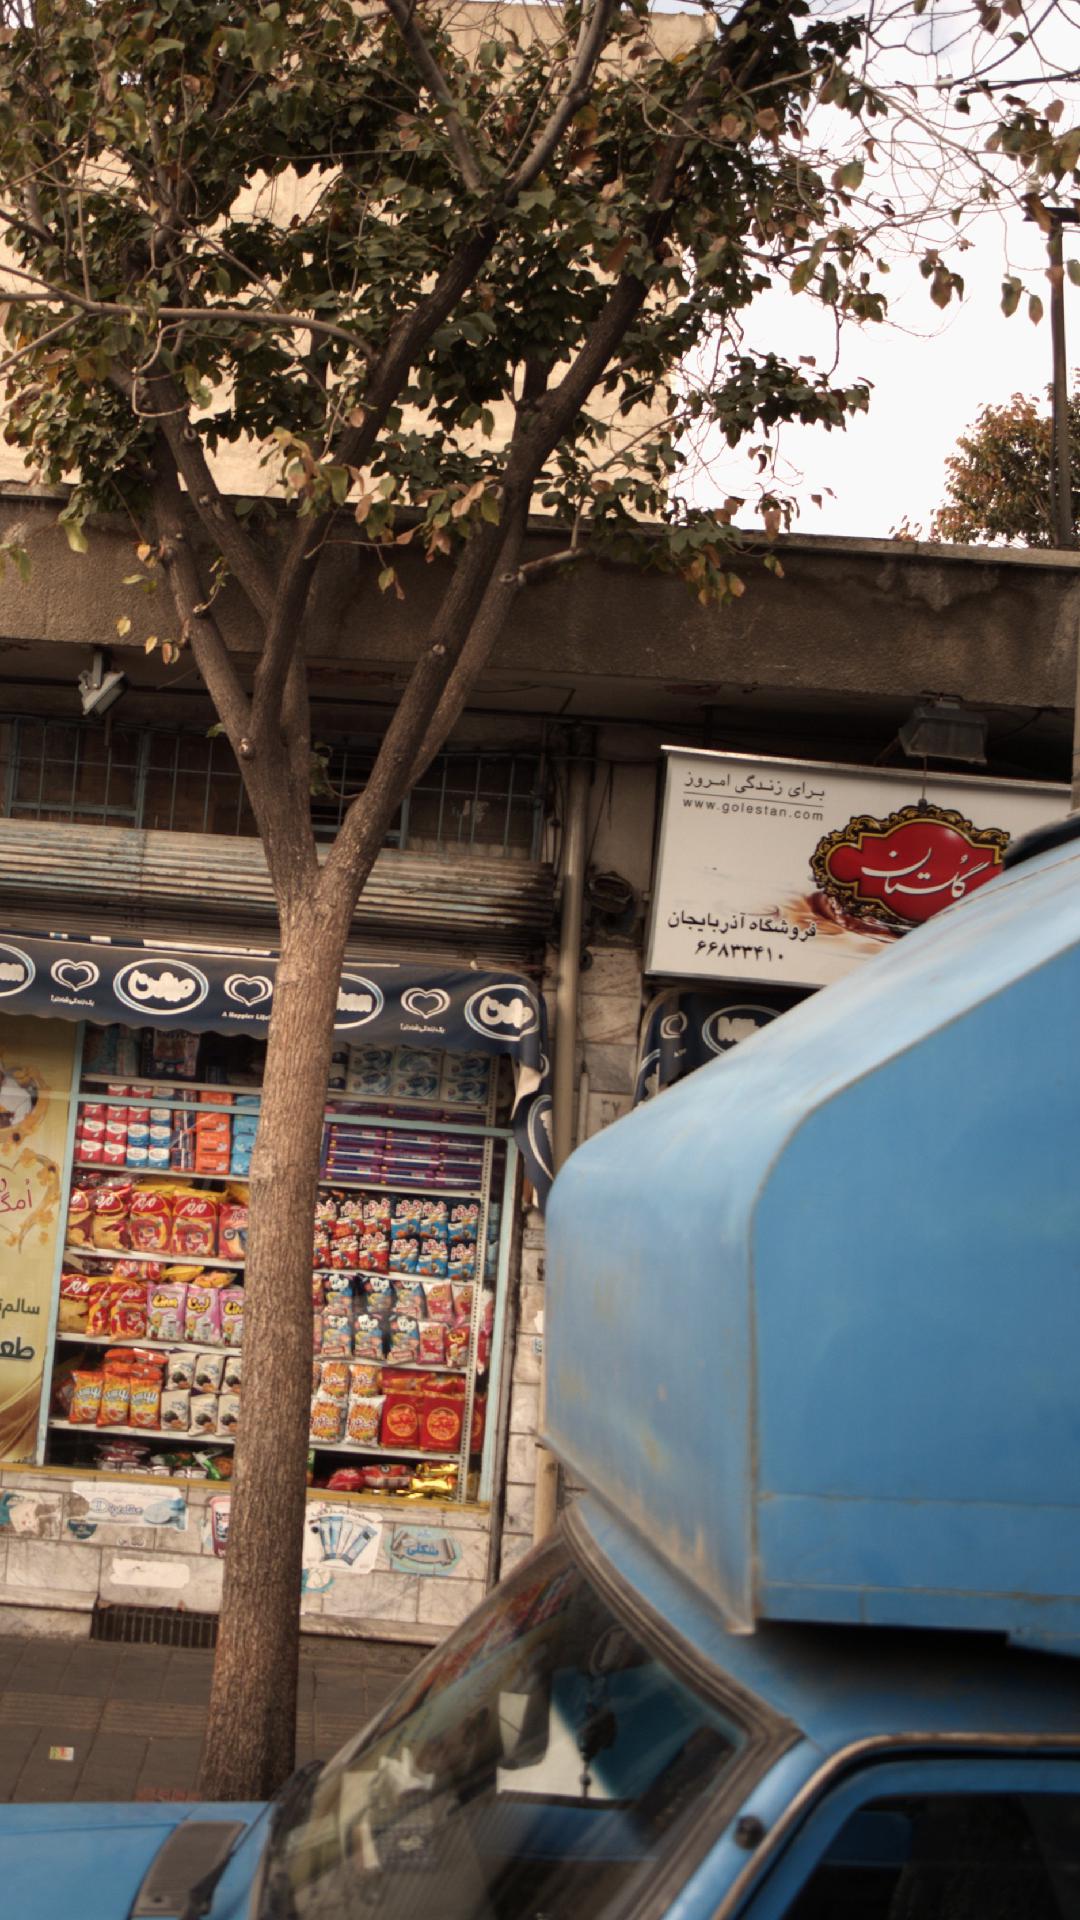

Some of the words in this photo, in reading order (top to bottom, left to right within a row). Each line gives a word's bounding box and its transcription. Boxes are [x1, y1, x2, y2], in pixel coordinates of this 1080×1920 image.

[684, 772, 731, 788] امروز
[735, 774, 783, 795] زندگی
[787, 781, 826, 801] برای
[682, 798, 824, 821] www.golestan.com
[667, 910, 746, 934] آذربایجان
[749, 918, 817, 942] فروشگاه
[694, 939, 784, 962] ۶۶۸۳۳۴۱۰
